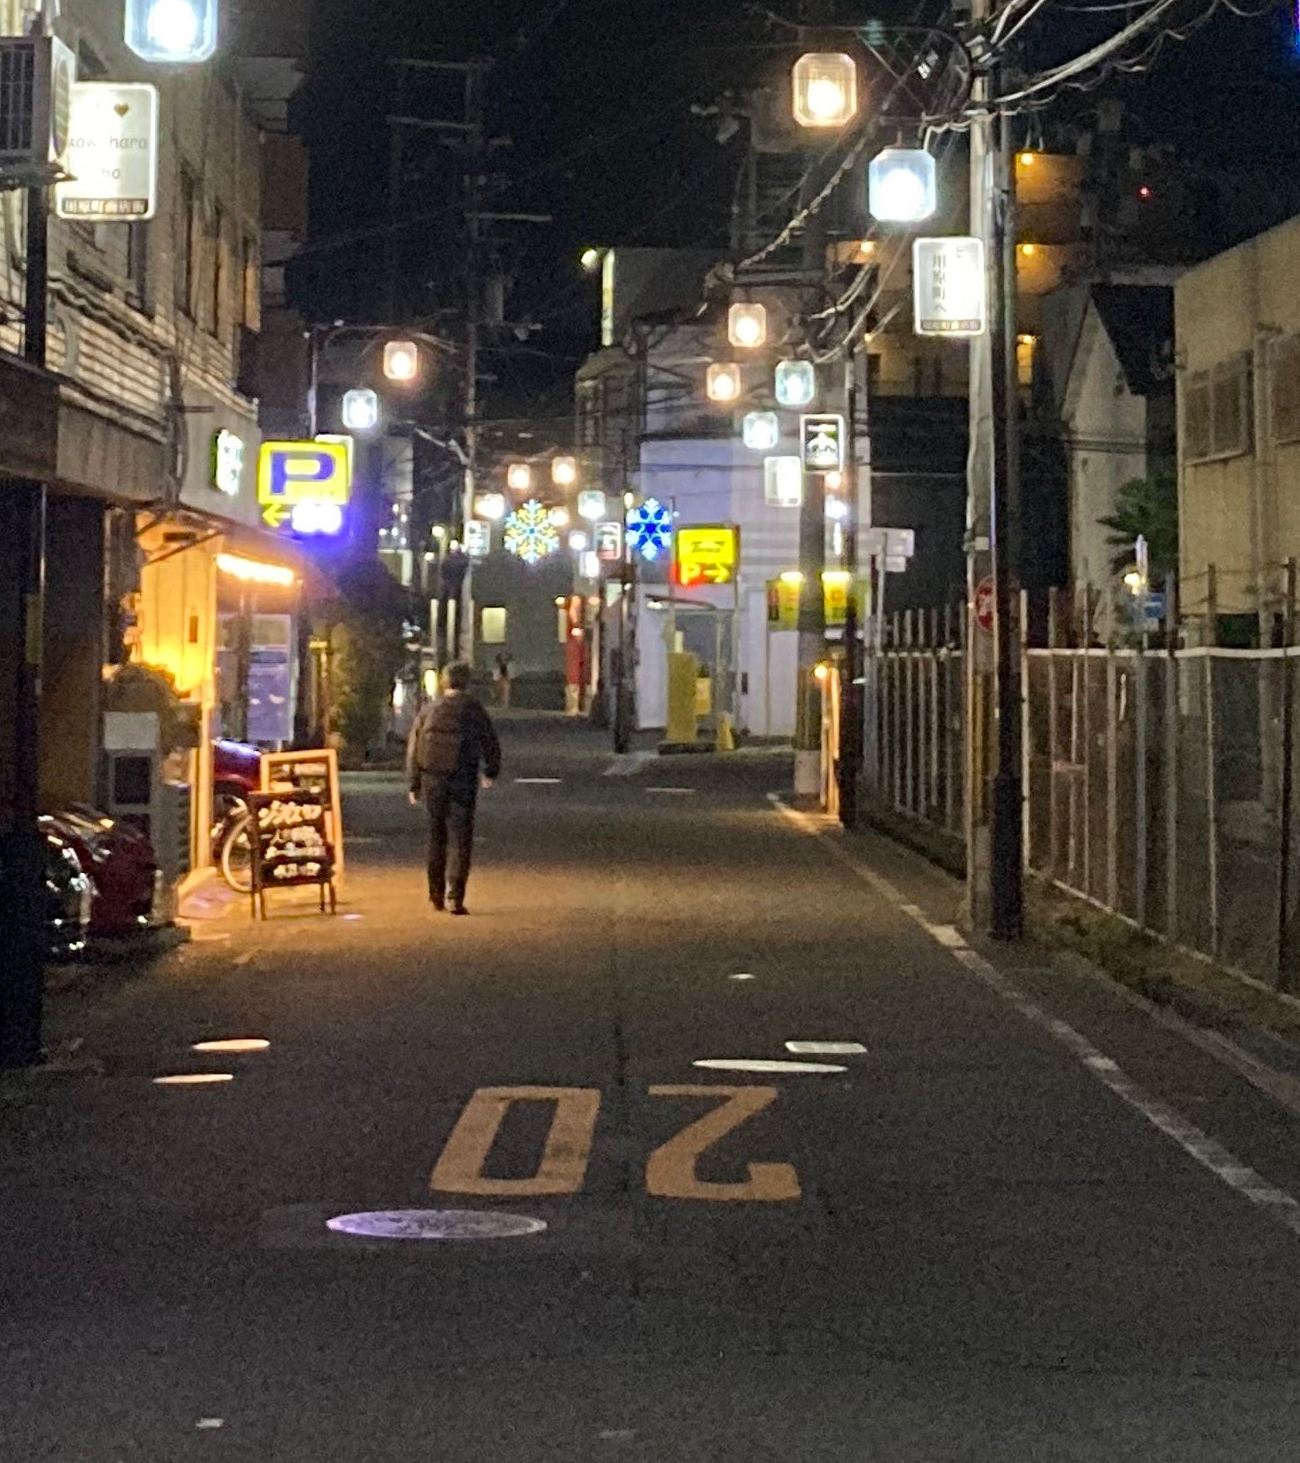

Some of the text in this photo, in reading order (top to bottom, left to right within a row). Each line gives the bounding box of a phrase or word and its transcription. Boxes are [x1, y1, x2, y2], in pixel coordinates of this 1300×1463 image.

[271, 451, 335, 495] P
[681, 562, 701, 587] P
[429, 1085, 803, 1201] 20
